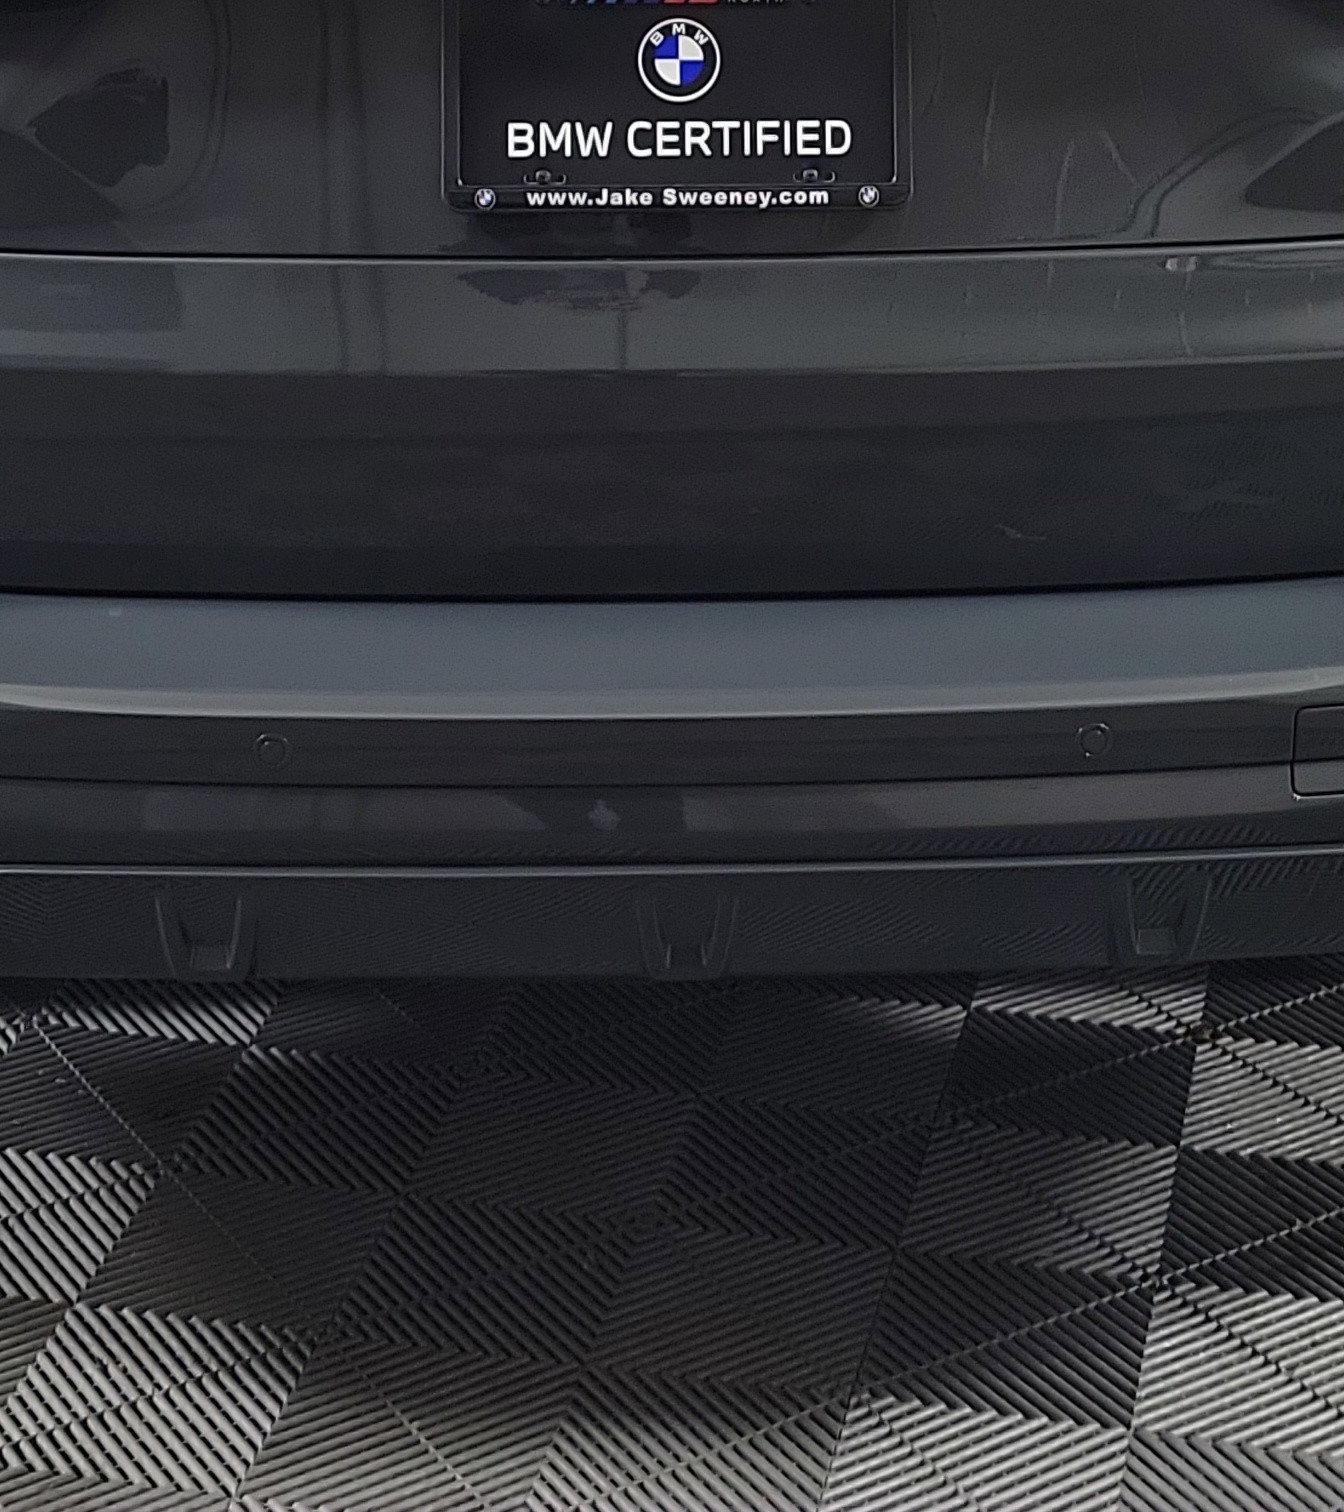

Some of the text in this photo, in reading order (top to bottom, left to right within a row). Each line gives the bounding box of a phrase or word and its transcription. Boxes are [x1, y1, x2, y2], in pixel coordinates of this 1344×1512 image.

[649, 23, 709, 47] BMW
[507, 120, 852, 158] BMW CERTIFIED
[526, 188, 830, 209] www.Jake Sweeney.com
